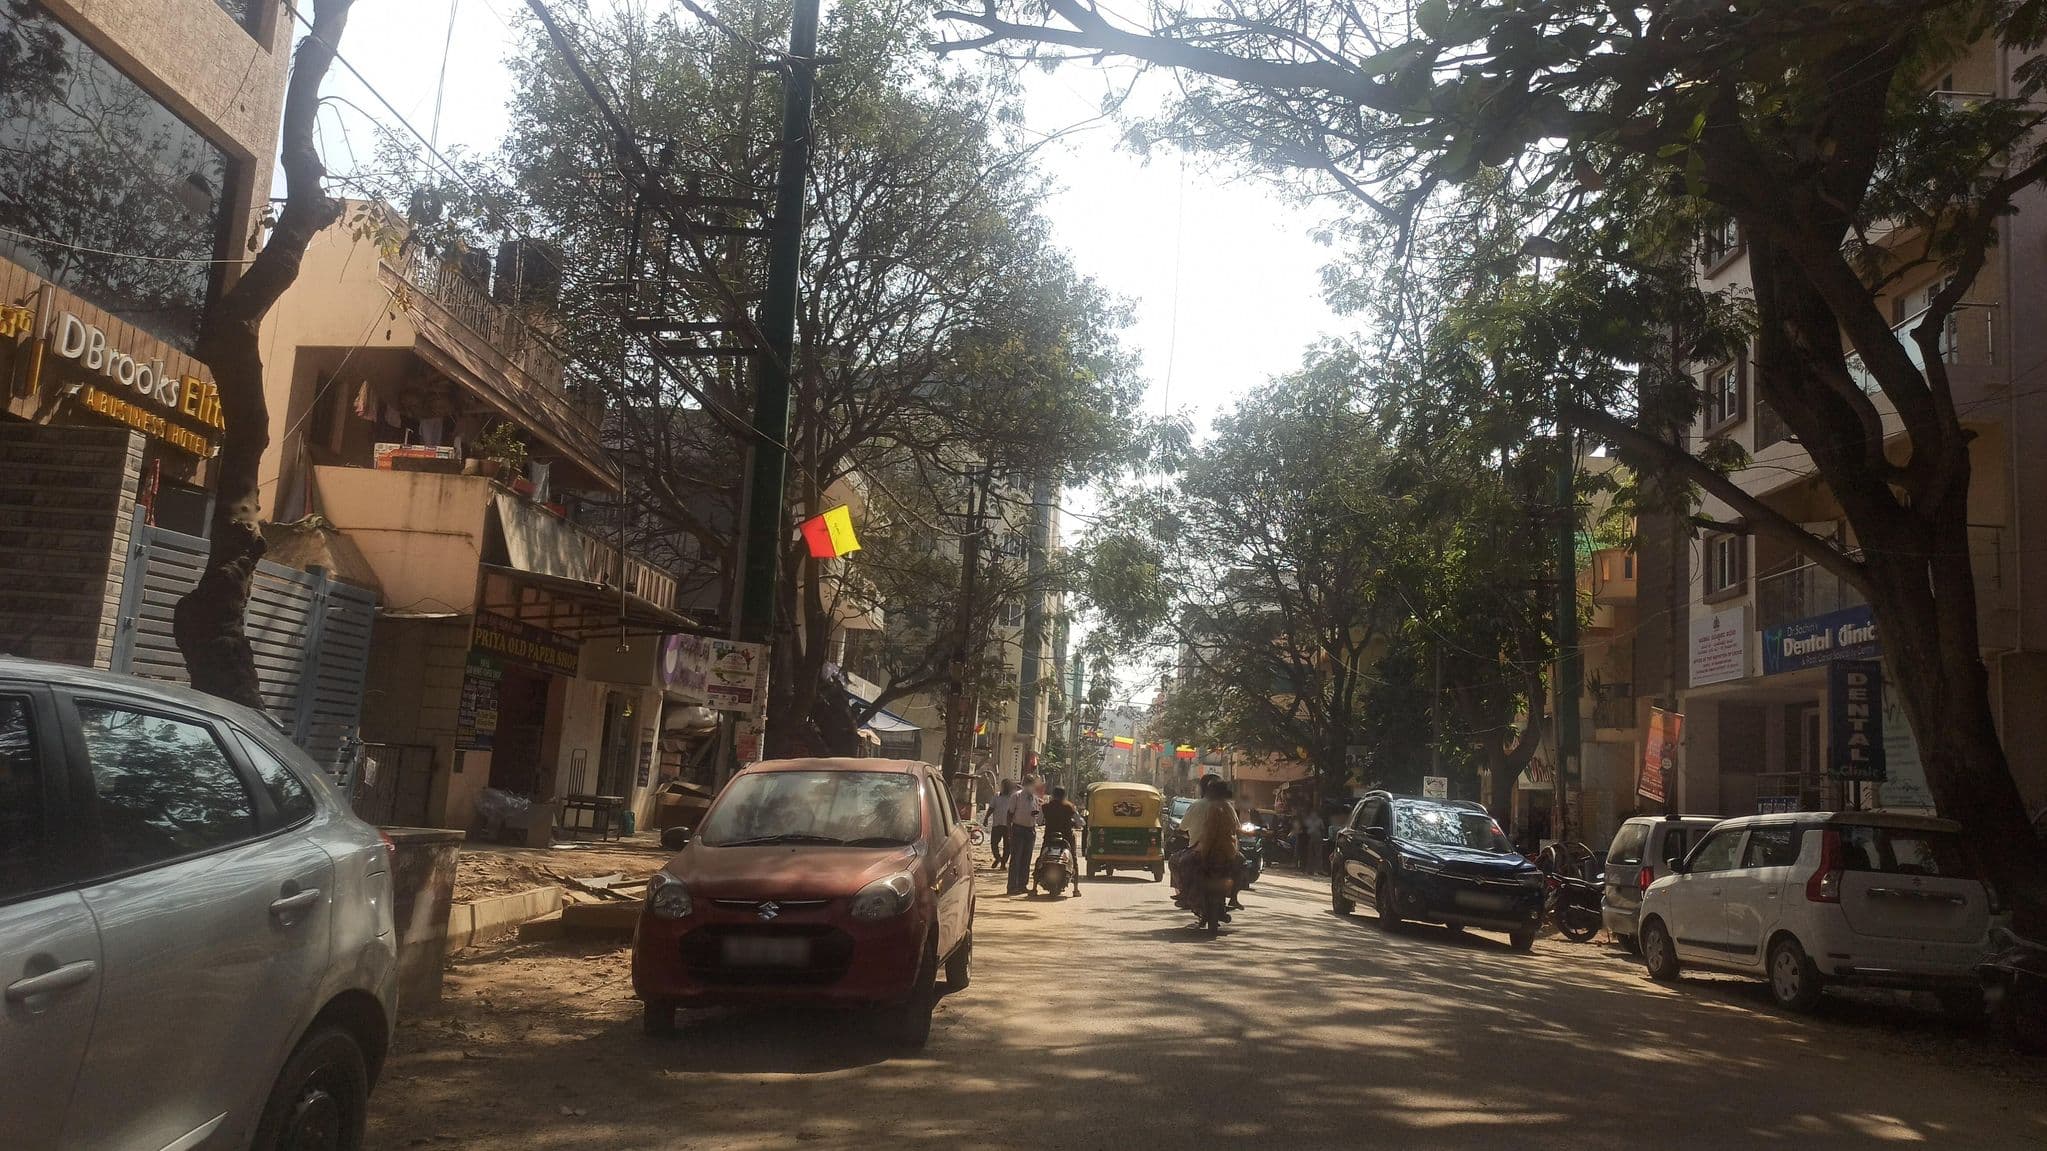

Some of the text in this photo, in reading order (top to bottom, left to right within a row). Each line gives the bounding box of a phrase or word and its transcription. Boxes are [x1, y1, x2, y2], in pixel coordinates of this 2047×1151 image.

[55, 311, 180, 407] DBrooks
[184, 377, 226, 431] Elit
[85, 387, 208, 457] A BUSINESS HOTEL
[475, 627, 506, 651] PRIYA
[508, 637, 527, 656] OLD
[528, 643, 556, 664] PAPER
[557, 651, 578, 671] SHOP
[1784, 628, 1830, 657] Dental
[1839, 620, 1876, 647] Clinic
[1847, 672, 1869, 761] DENTAL
